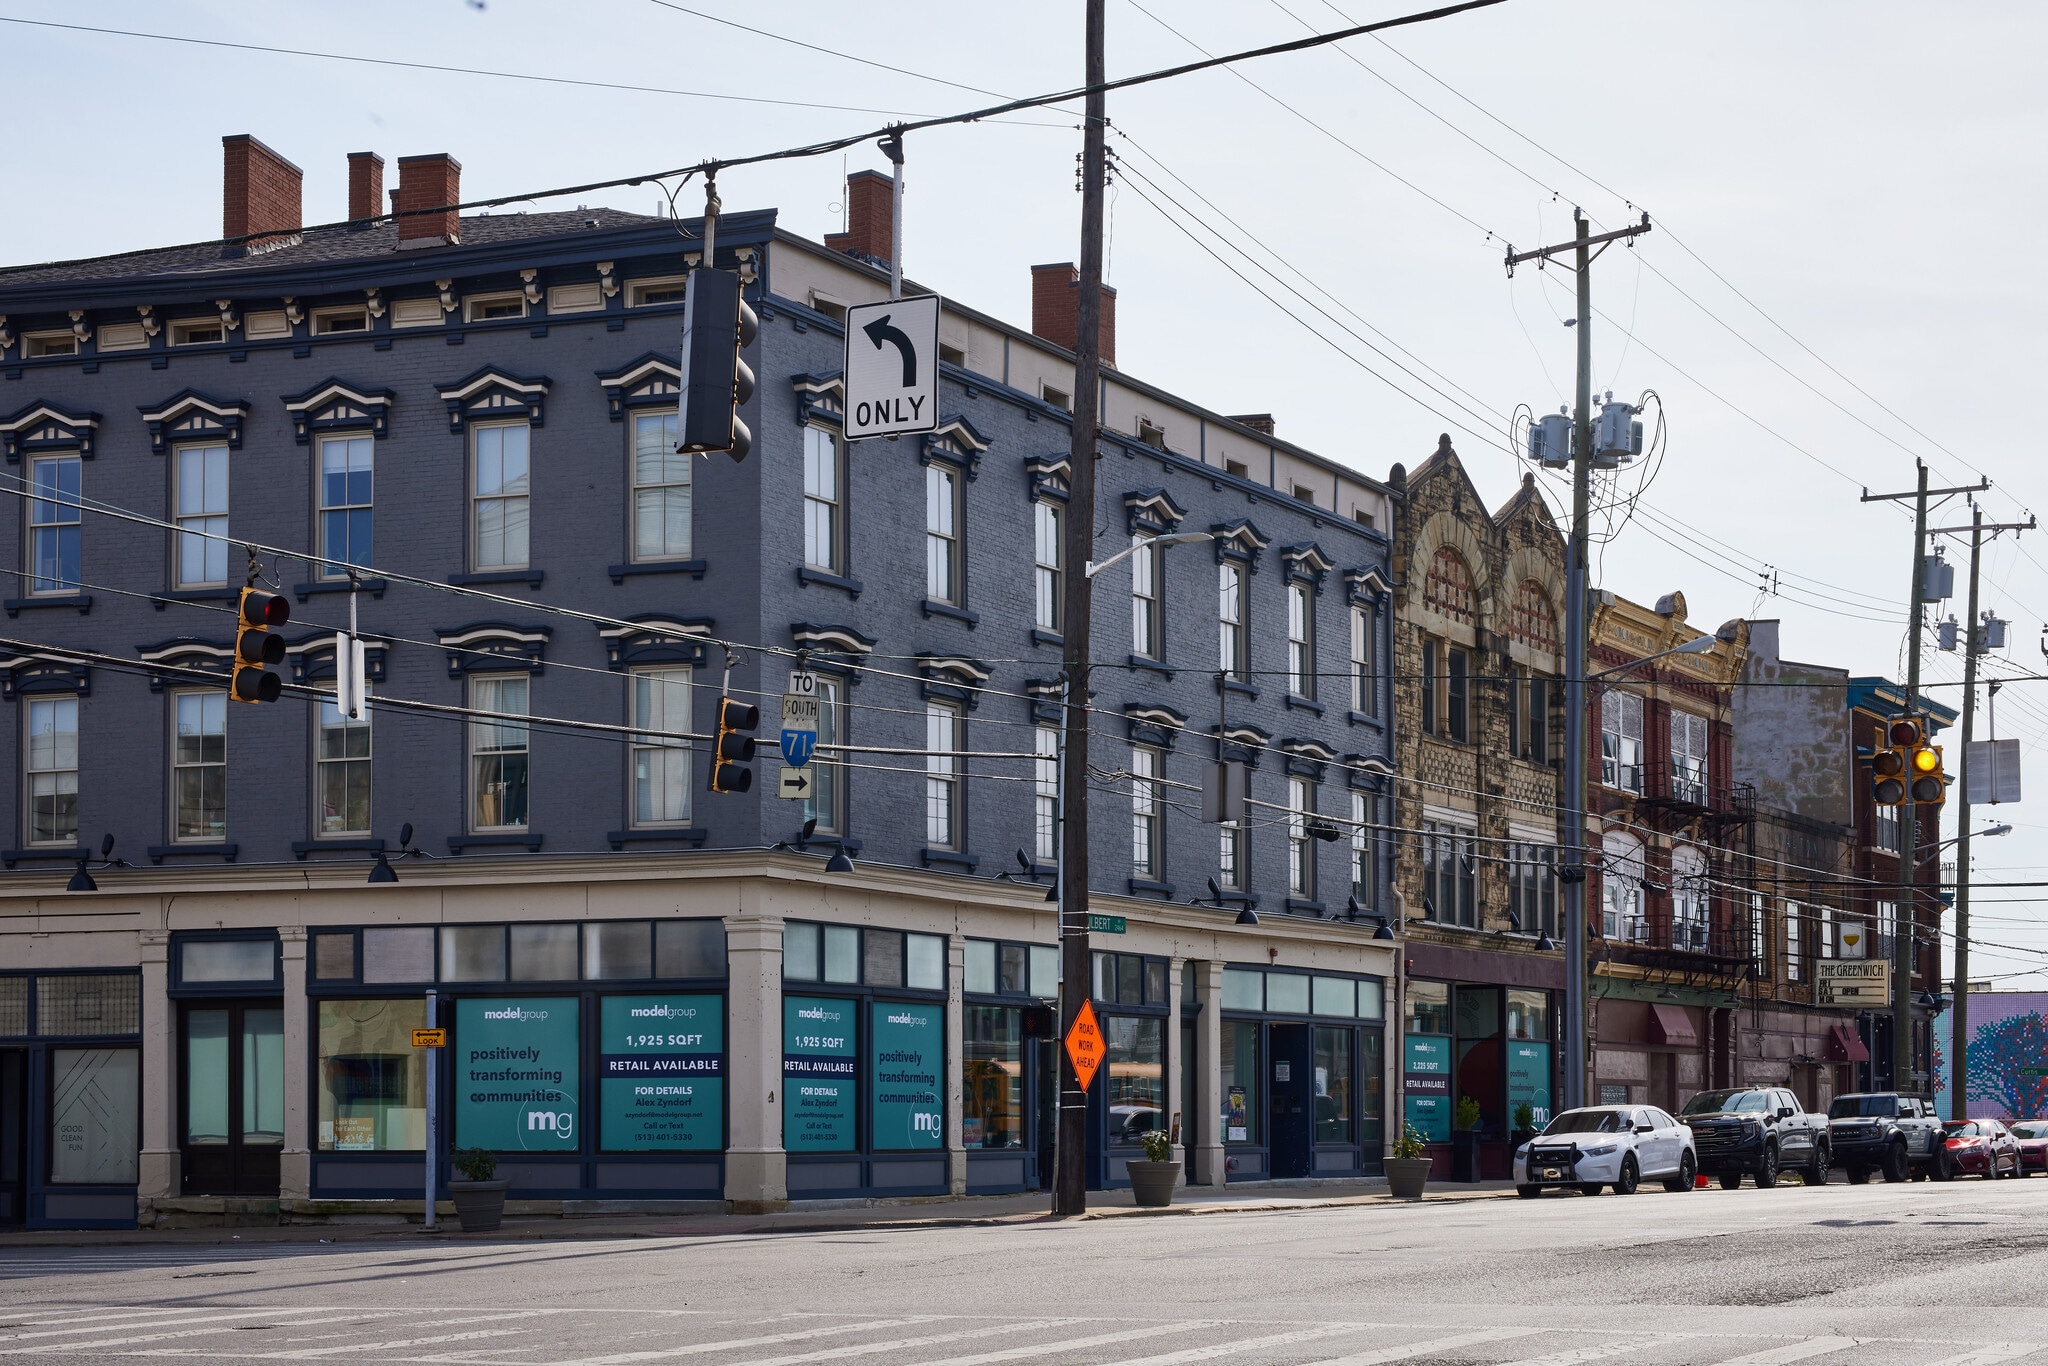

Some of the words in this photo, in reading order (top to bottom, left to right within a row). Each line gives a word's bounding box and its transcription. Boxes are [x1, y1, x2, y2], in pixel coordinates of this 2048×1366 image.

[856, 395, 925, 427] ONLY
[793, 675, 812, 692] TO
[785, 699, 817, 716] SOUTH
[786, 733, 807, 757] 71
[1820, 964, 1836, 977] THE
[1836, 964, 1884, 977] GREENWICH
[1818, 987, 1834, 995] SAT
[1841, 987, 1859, 995] OPEN
[485, 1007, 548, 1021] modelgroup
[631, 1005, 696, 1019] modelgroup
[798, 1007, 841, 1022] modelgroup
[888, 1013, 927, 1028] modelgroup
[1078, 1022, 1095, 1036] ROAD
[626, 1034, 664, 1047] 1,925
[668, 1034, 703, 1046] SQFT
[795, 1035, 820, 1048] 1,925
[822, 1037, 845, 1048] SQFT
[1078, 1039, 1094, 1053] WORK
[470, 1047, 541, 1063] positively
[879, 1050, 922, 1067] positively
[610, 1061, 650, 1071] RETAIL
[653, 1060, 719, 1070] AVAILABLE
[784, 1061, 811, 1071] RETAIL
[812, 1062, 854, 1073] AVAILABLE
[1076, 1056, 1095, 1069] AHEAD
[470, 1068, 562, 1084] transforming
[879, 1070, 936, 1087] transforming
[635, 1086, 654, 1095] FOR
[656, 1086, 693, 1095] DETAILS
[1406, 1080, 1421, 1088] RETAIL
[1422, 1080, 1446, 1089] AVAILABLE
[470, 1089, 562, 1103] communities
[801, 1087, 813, 1096] FOR
[814, 1087, 838, 1097] DETAILS
[879, 1091, 936, 1104] communities
[635, 1098, 655, 1106] Alex
[657, 1098, 692, 1109] Zyndorf
[60, 1125, 85, 1133] GOOD.
[528, 1111, 573, 1139] mg
[643, 1122, 658, 1130] Call
[668, 1122, 684, 1130] Text
[914, 1112, 942, 1139] mg
[634, 1133, 655, 1142] (513)
